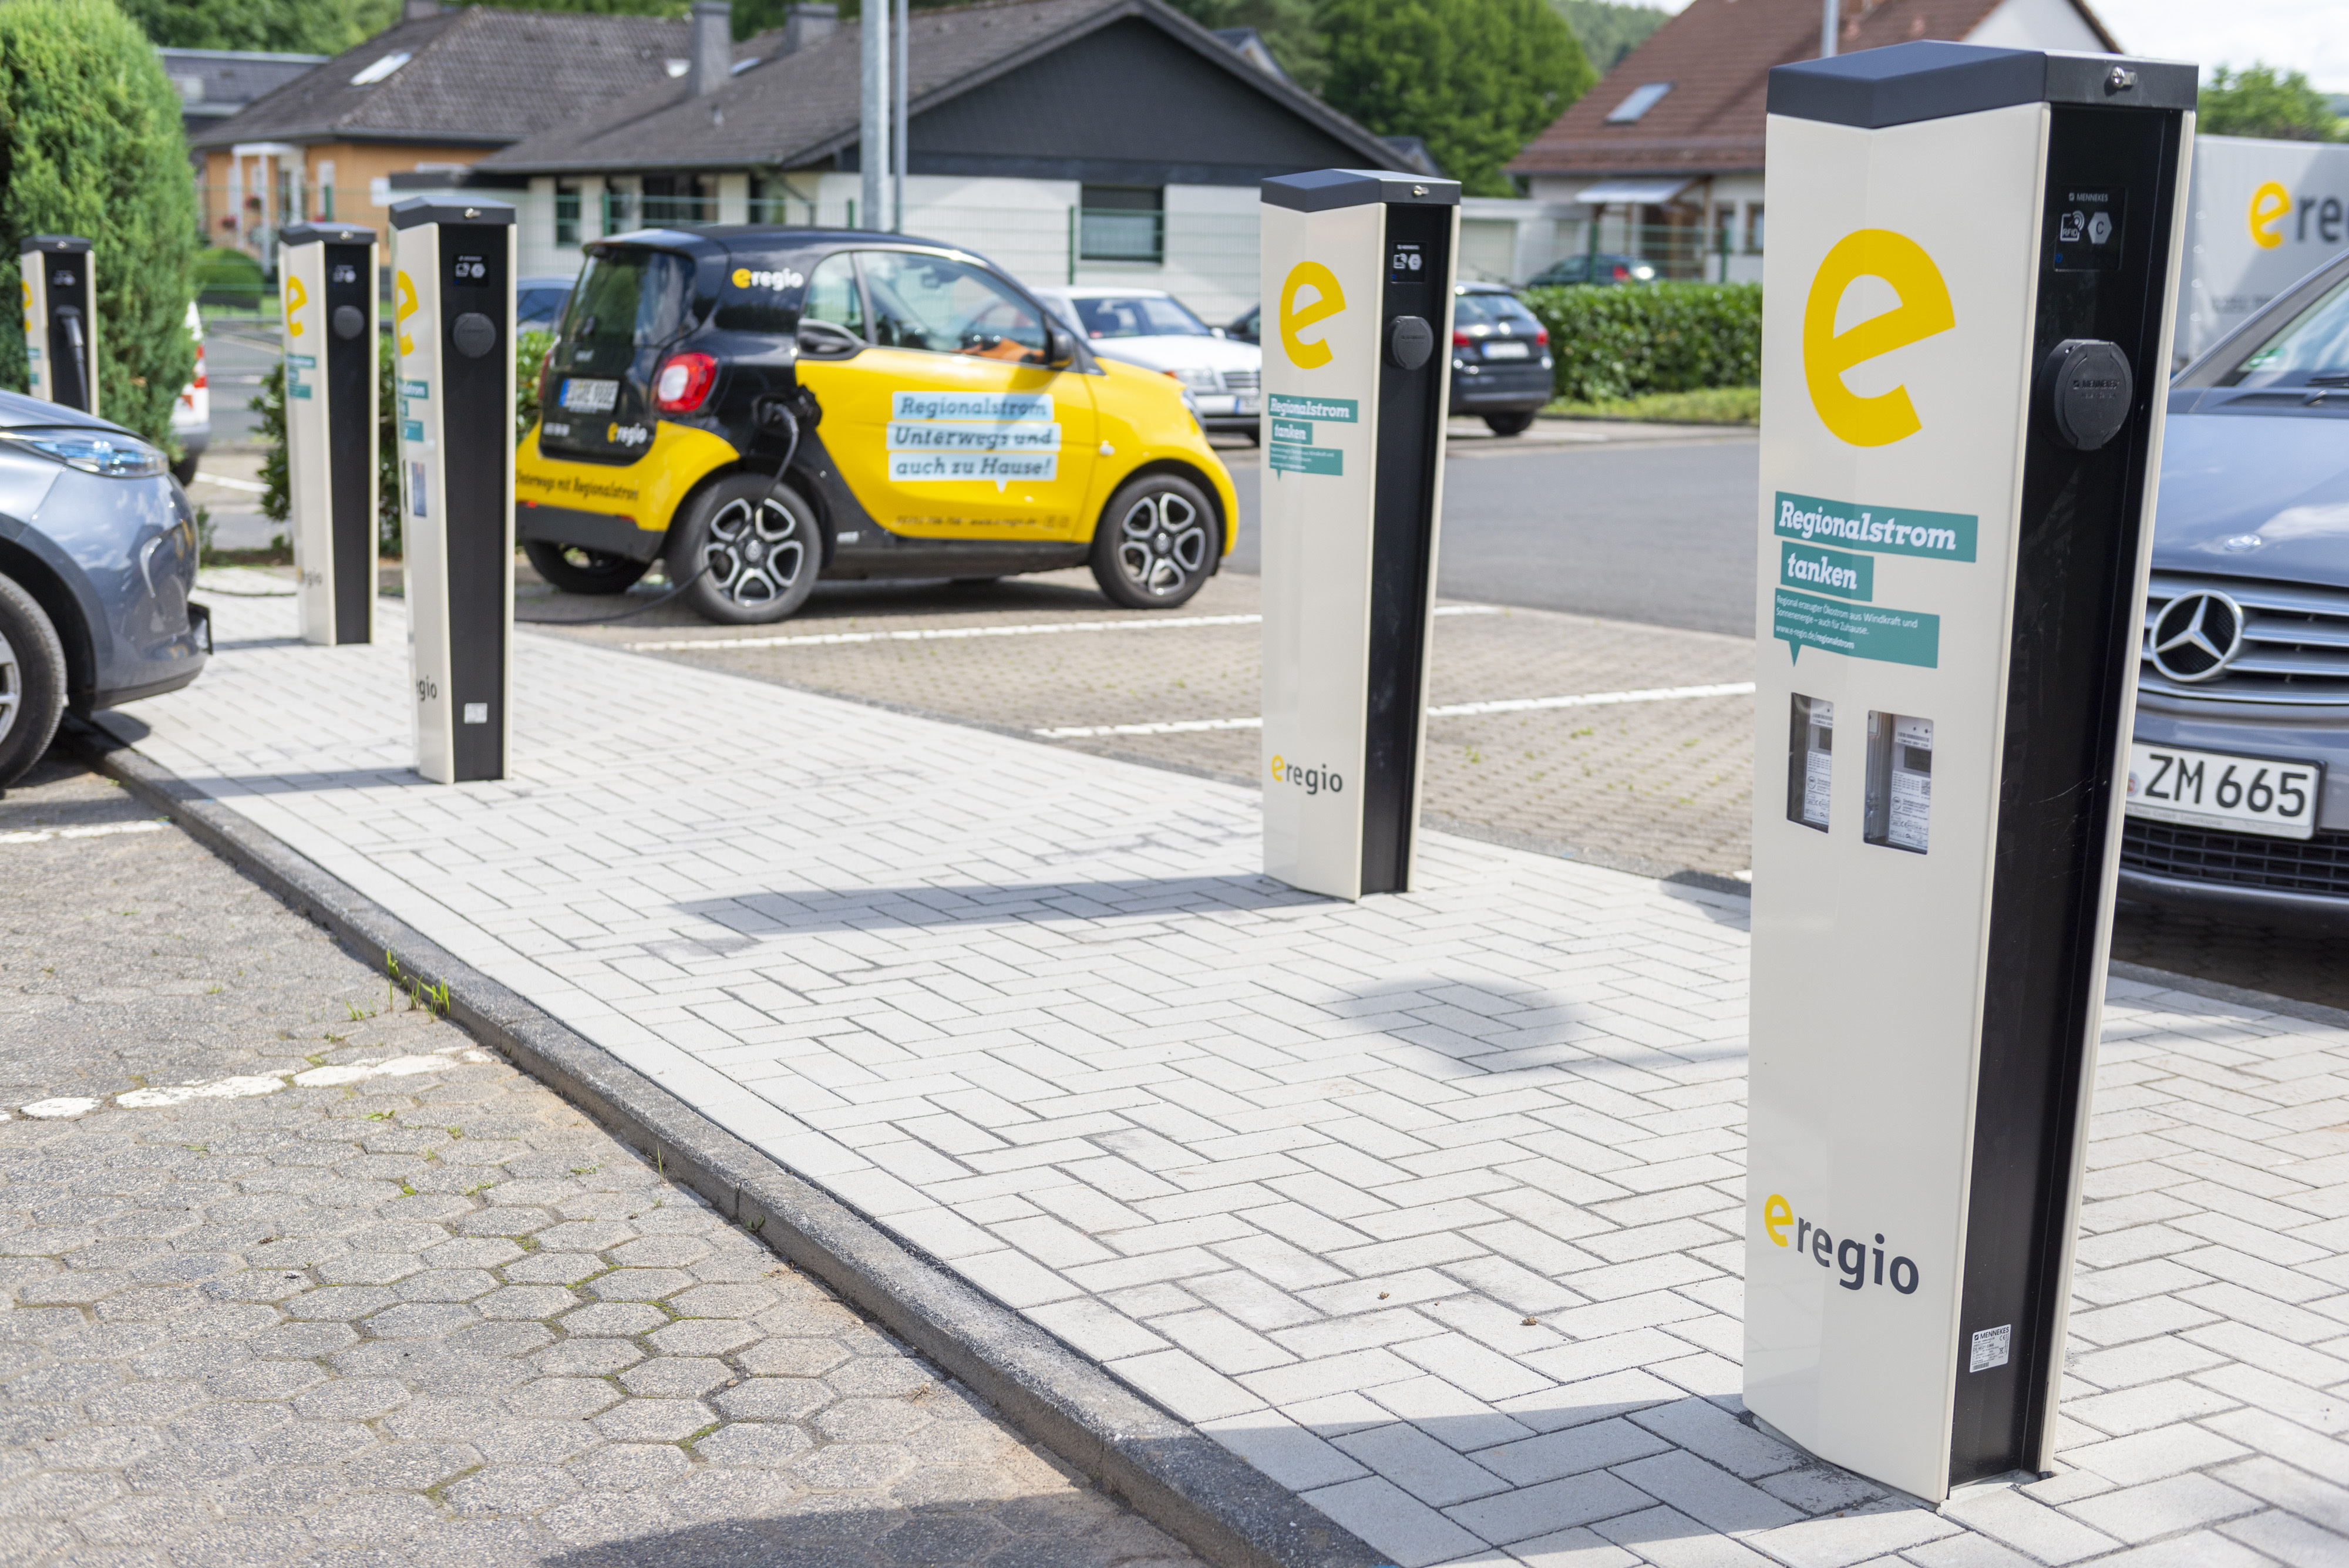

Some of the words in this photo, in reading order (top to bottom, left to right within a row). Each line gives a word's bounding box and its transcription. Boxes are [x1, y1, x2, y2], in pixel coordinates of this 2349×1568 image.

[2077, 193, 2108, 202] MENNEKES
[2248, 180, 2349, 248] ere
[2062, 228, 2078, 237] RFID
[2096, 221, 2104, 234] C
[732, 268, 804, 291] eregio
[1280, 261, 1346, 369] e
[1803, 228, 1956, 447] e
[901, 396, 1046, 419] Regionalstrom
[1270, 398, 1350, 418] Regionalstrom
[607, 422, 648, 446] eregio
[895, 426, 1008, 450] Unterwegs
[1013, 429, 1052, 445] und
[1274, 424, 1307, 440] tanken
[896, 458, 945, 476] auch
[952, 460, 973, 474] zu
[980, 456, 1054, 476] Hause!
[1779, 500, 1957, 550] Regionalstrom
[1787, 552, 1857, 590] tanken
[1776, 595, 1799, 607] Regional
[1798, 601, 1823, 613] erzeugter
[1823, 604, 1849, 618] Ökostrom
[1849, 612, 1862, 621] aus
[1863, 613, 1901, 626] Windkraft
[1902, 618, 1918, 628] und
[1776, 607, 1813, 624] Sonnenenergie
[1818, 618, 1831, 628] auch
[1831, 619, 1840, 629] für
[1271, 754, 1342, 795] eregio
[2145, 752, 2205, 804] ZM
[2216, 765, 2308, 817] 665
[1764, 1193, 1919, 1294] eregio
[1980, 1327, 2009, 1339] MENNEKES
